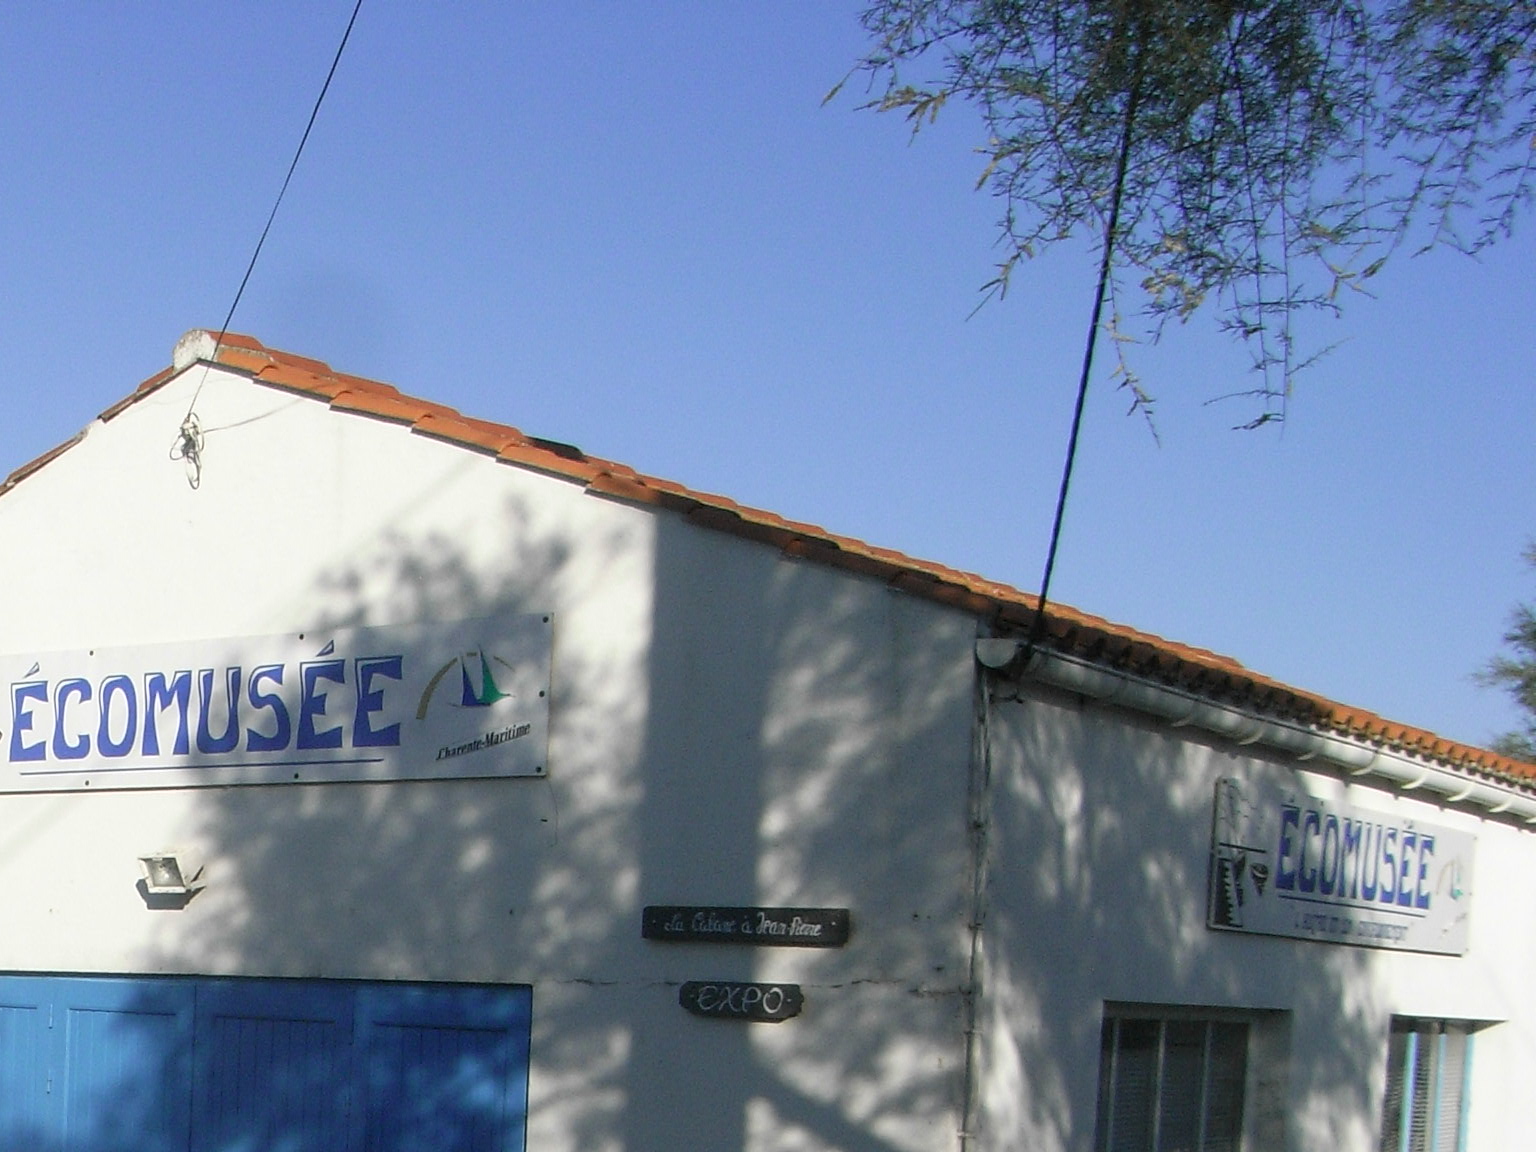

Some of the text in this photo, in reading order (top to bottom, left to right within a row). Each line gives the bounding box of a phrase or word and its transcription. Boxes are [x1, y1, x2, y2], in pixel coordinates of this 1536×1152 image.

[9, 639, 403, 763] ÉCOMUSÉE
[435, 723, 531, 761] Charente-Maritime
[697, 985, 784, 1015] EXPO
